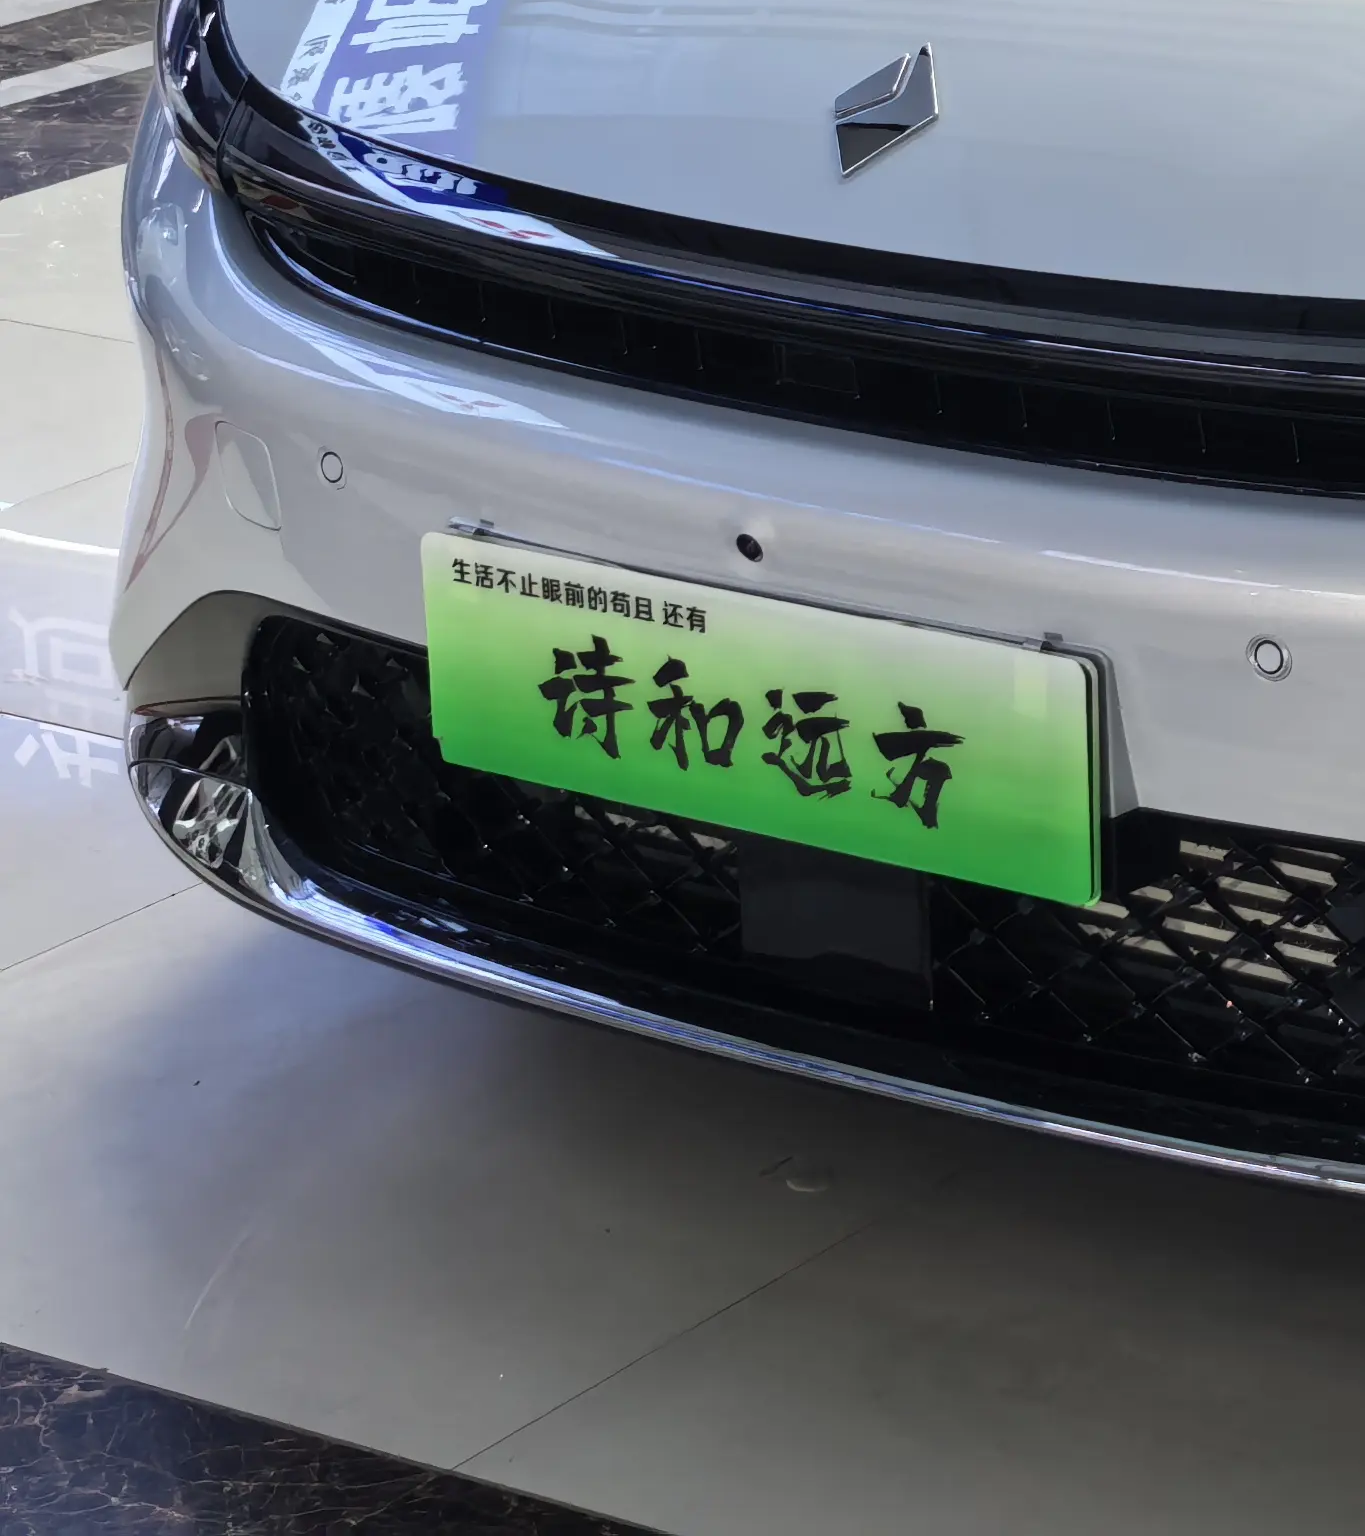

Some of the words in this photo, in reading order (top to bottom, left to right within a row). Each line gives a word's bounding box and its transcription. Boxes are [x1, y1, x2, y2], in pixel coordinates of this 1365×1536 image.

[451, 558, 656, 624] 生活不止眼前的苟且
[662, 600, 707, 635] 还有
[538, 635, 965, 829] 诗和远方
